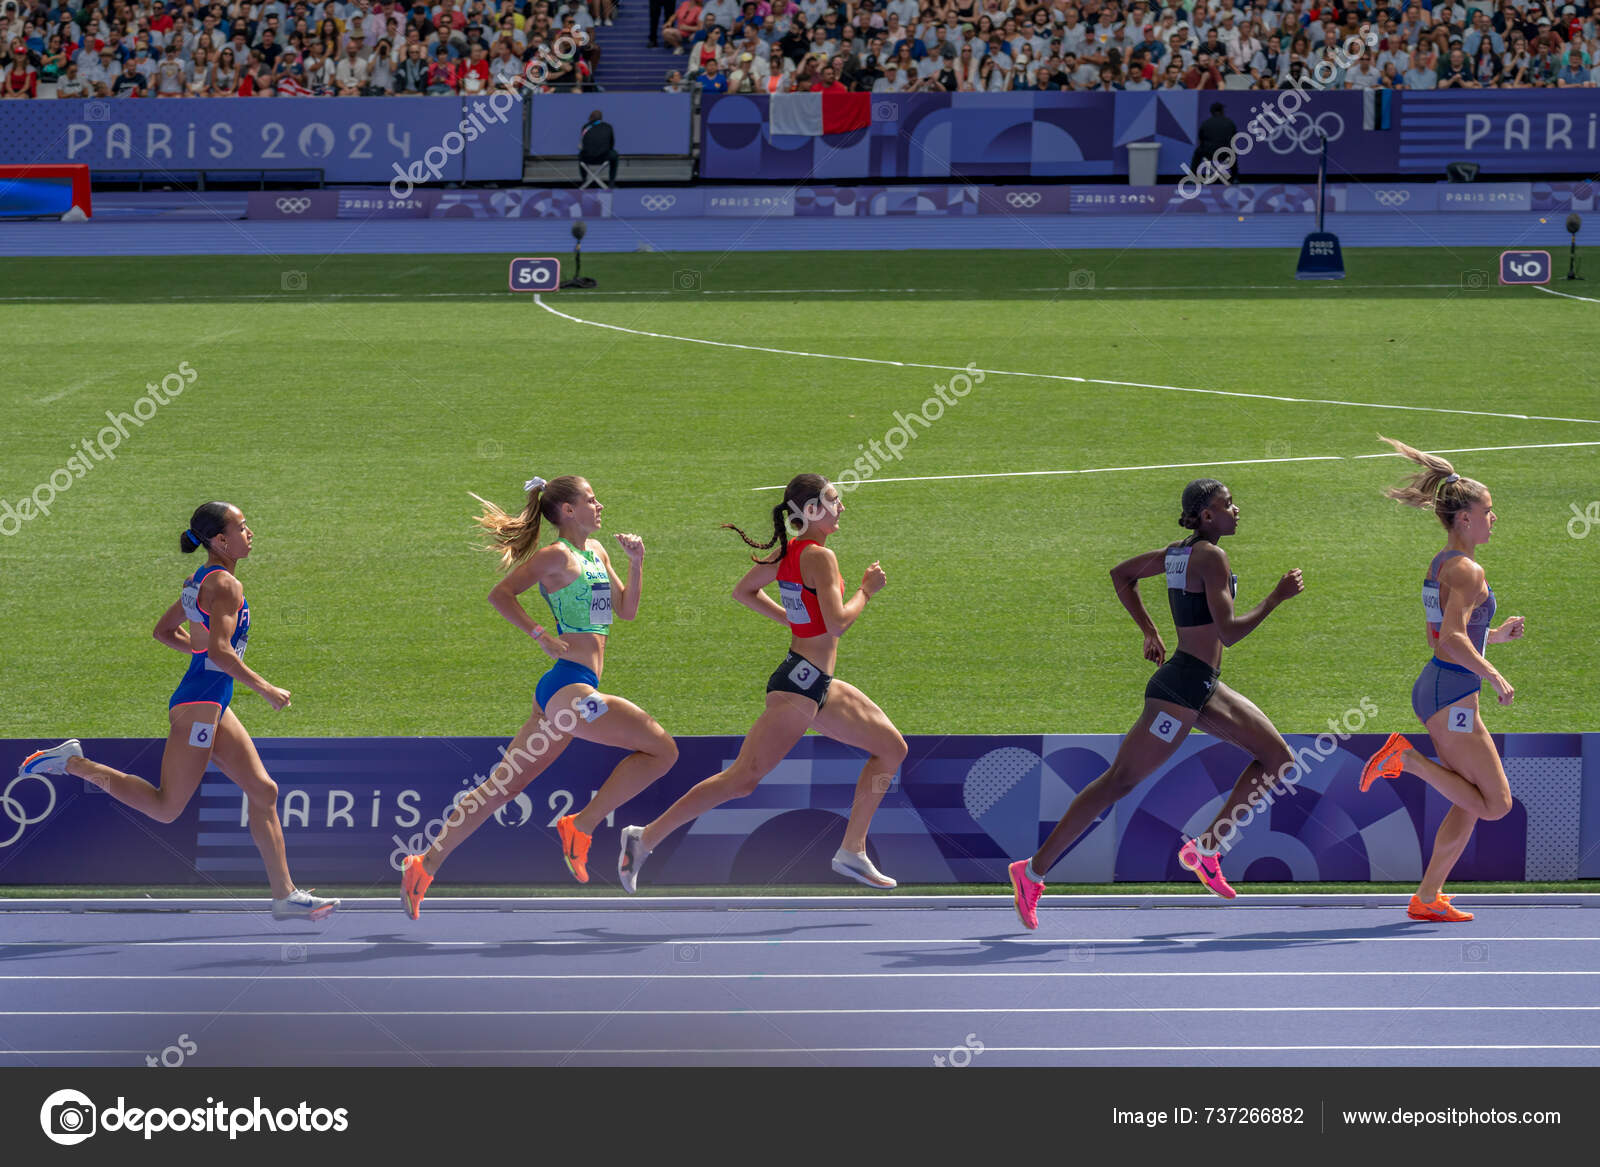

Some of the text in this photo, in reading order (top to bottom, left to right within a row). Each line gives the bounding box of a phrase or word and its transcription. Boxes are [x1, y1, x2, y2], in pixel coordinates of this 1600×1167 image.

[261, 122, 412, 159] 2024
[518, 267, 550, 284] 50
[1510, 260, 1541, 277] 40
[797, 667, 811, 682] 3
[586, 700, 598, 714] 9
[1159, 719, 1173, 735] 8
[1456, 712, 1467, 728] 2
[197, 727, 208, 743] 6
